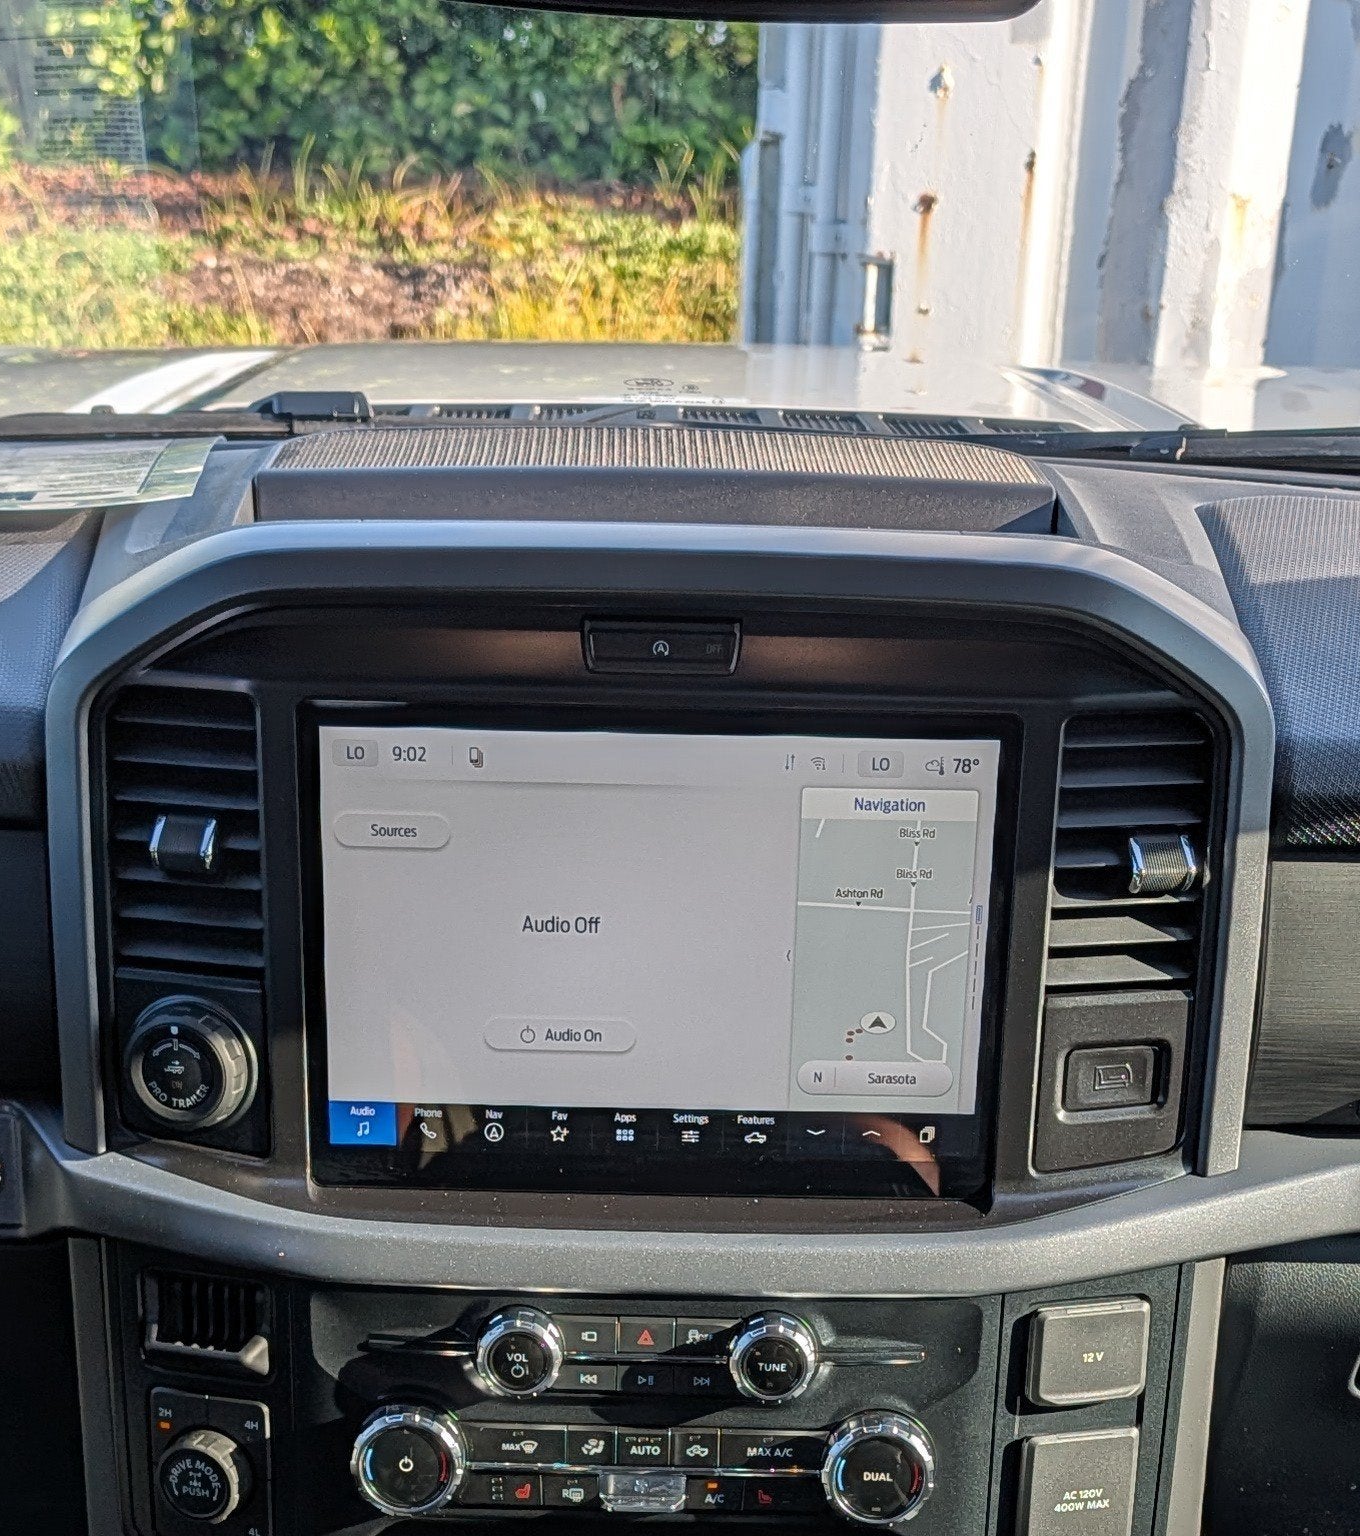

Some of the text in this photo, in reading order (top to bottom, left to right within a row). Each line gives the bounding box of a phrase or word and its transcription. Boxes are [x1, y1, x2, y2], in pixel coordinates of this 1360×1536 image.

[346, 745, 365, 760] LO
[392, 746, 426, 762] 9:02
[871, 757, 890, 771] LO
[952, 757, 980, 774] 78°
[853, 797, 926, 815] Navigation
[370, 823, 417, 837] Sources
[899, 827, 935, 839] Bliss Rd
[896, 868, 933, 880] Bliss Rd
[835, 888, 883, 899] Ashton Rd
[522, 915, 601, 933] Audio Off
[545, 1028, 602, 1043] Audio On
[813, 1072, 822, 1083] N
[867, 1072, 917, 1085] Sarasota
[148, 1081, 210, 1108] PRO TRAILER
[350, 1105, 375, 1116] Audio
[414, 1107, 443, 1118] Phone
[485, 1109, 503, 1120] Nav
[551, 1110, 569, 1122] Fav
[614, 1112, 637, 1124] Apps
[672, 1113, 709, 1126] Settings
[737, 1114, 776, 1126] Features
[506, 1353, 528, 1363] VOL
[1083, 1352, 1104, 1362] 12 V
[757, 1362, 787, 1373] TUNE
[158, 1407, 172, 1418] 2H
[244, 1420, 259, 1431] 4H
[501, 1443, 520, 1451] MAX
[630, 1445, 661, 1456] AUTO
[746, 1447, 793, 1458] MAX A/C
[169, 1459, 221, 1489] DRIVE MODE
[863, 1471, 893, 1482] DUAL
[182, 1486, 209, 1497] PUSH
[1063, 1488, 1104, 1501] AC 120V
[704, 1493, 724, 1504] A/C
[1054, 1499, 1110, 1513] 400W MAX
